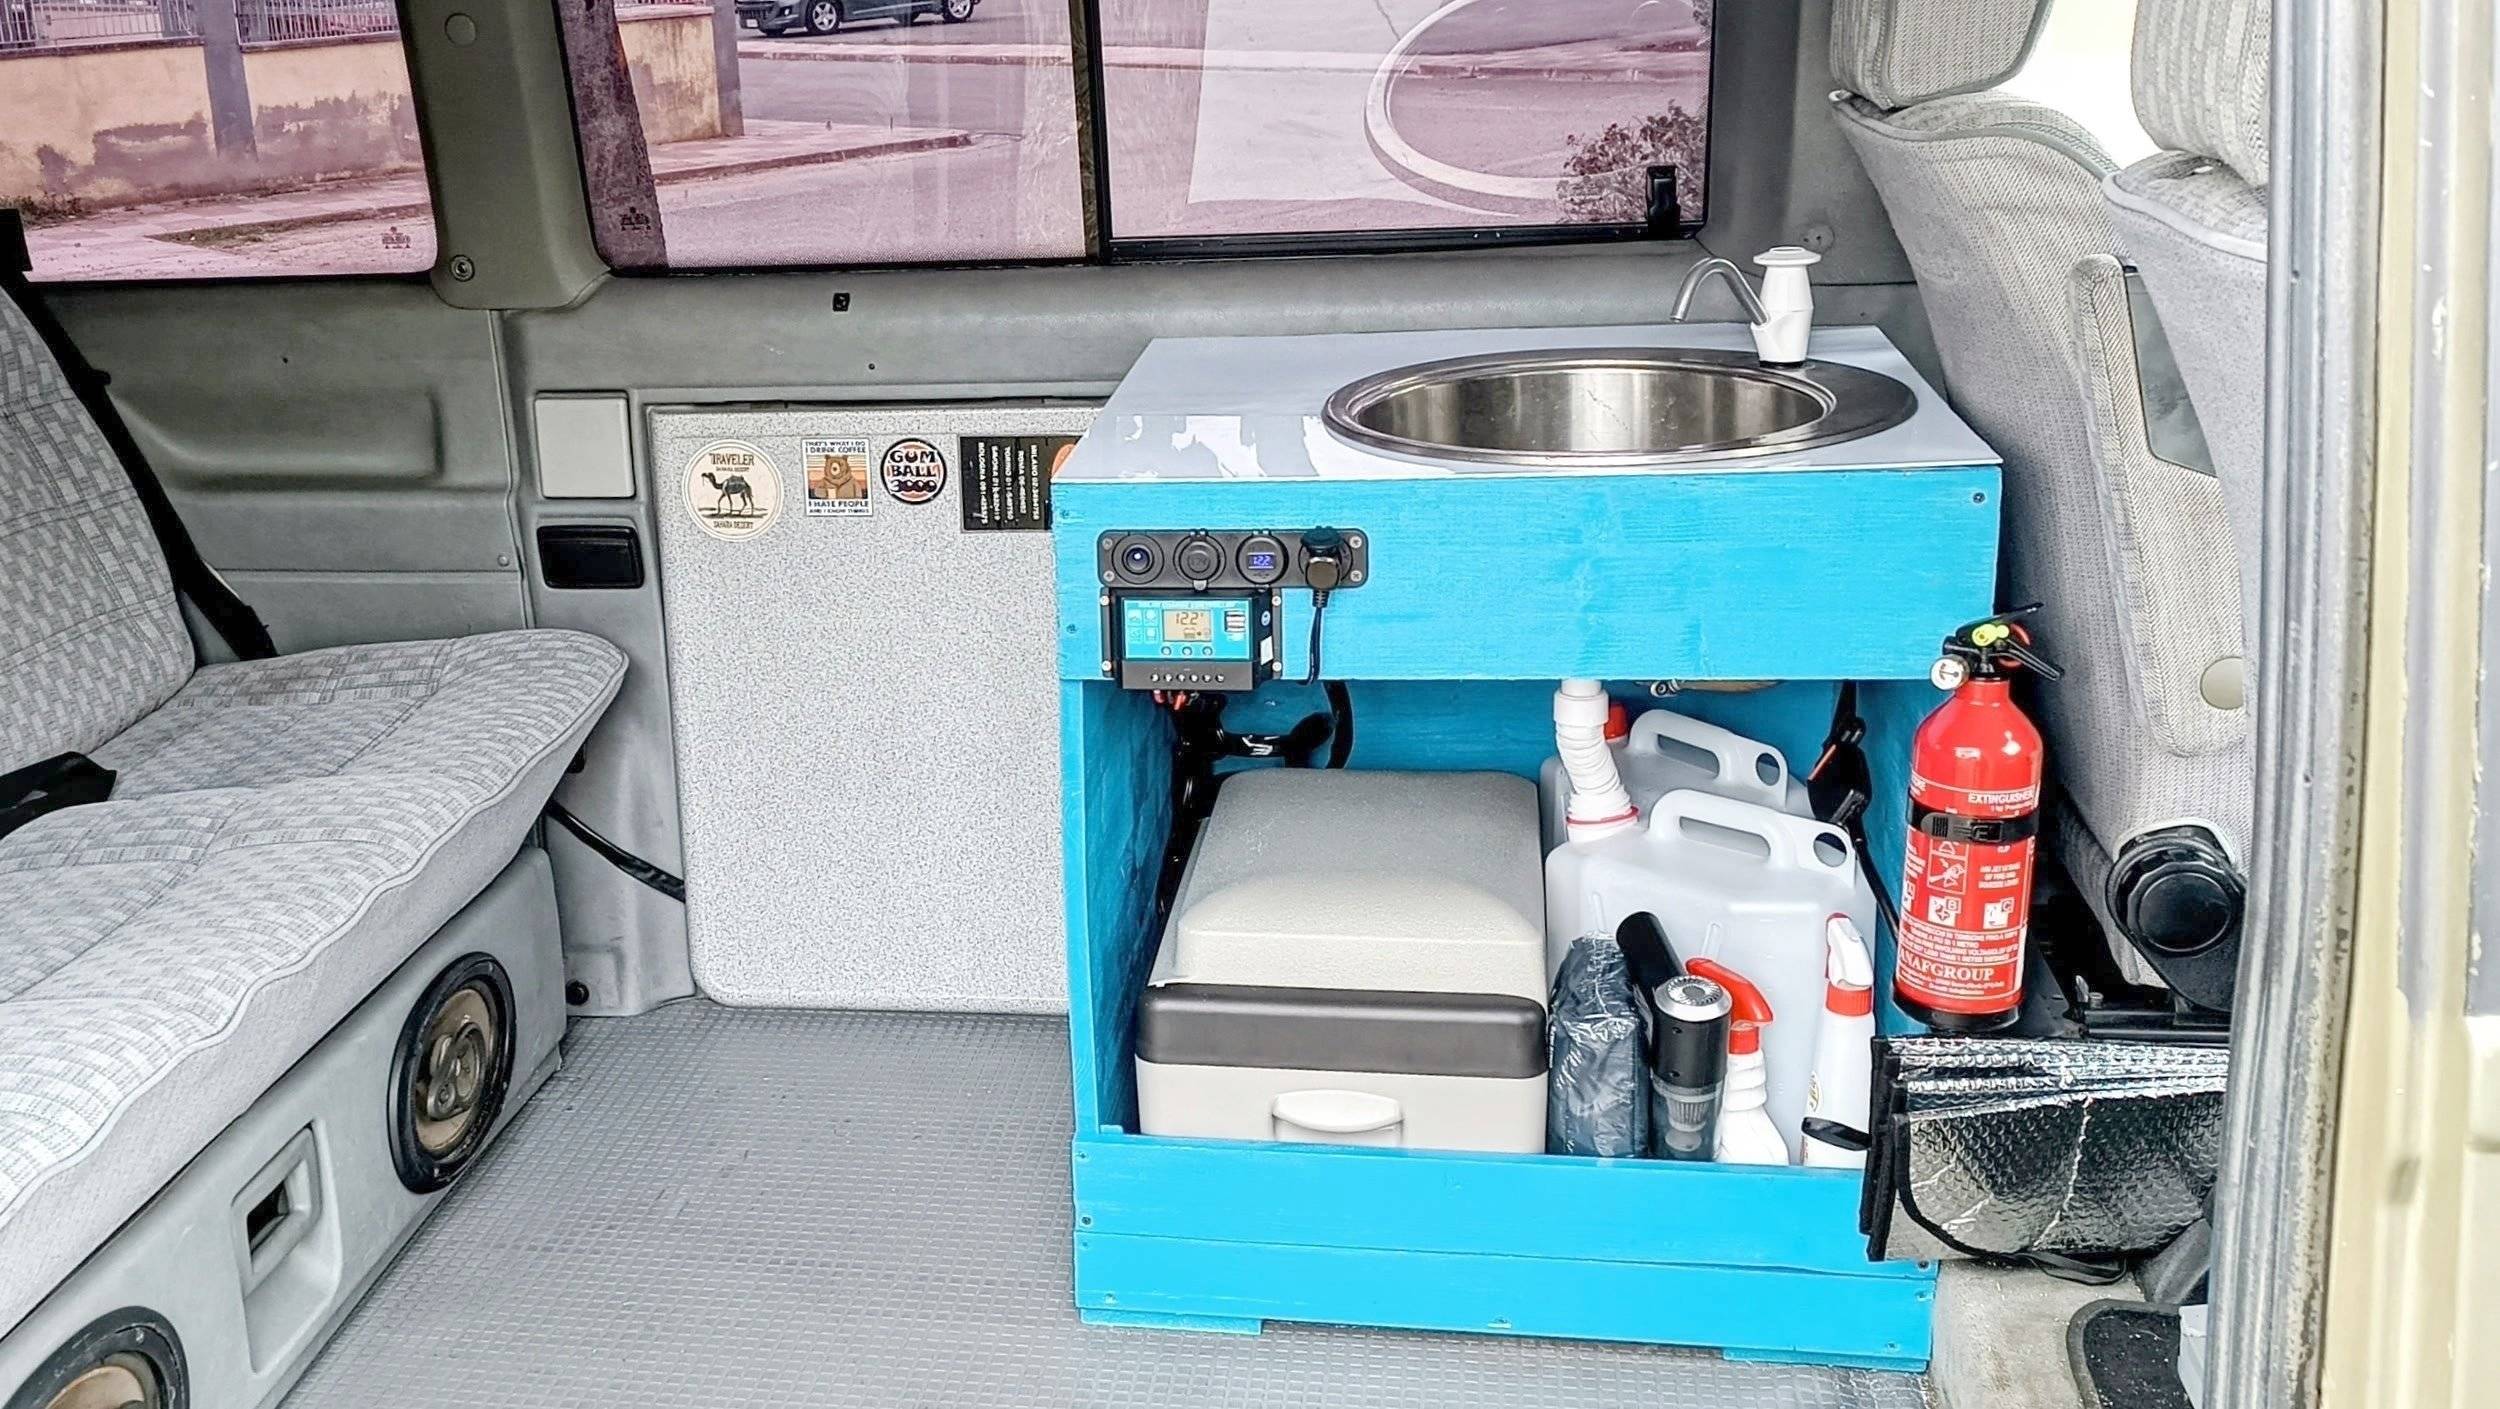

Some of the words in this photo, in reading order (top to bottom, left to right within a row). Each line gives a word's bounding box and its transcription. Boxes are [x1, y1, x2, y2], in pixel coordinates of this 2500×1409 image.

[709, 453, 755, 466] TRAVELER
[890, 450, 936, 463] GUM
[978, 442, 987, 480] BOLOGNA
[1004, 446, 1012, 476] TORINO
[1030, 444, 1038, 477] MILANO
[891, 465, 936, 477] BALL
[890, 479, 937, 492] 3000
[838, 500, 869, 508] PEOPLE
